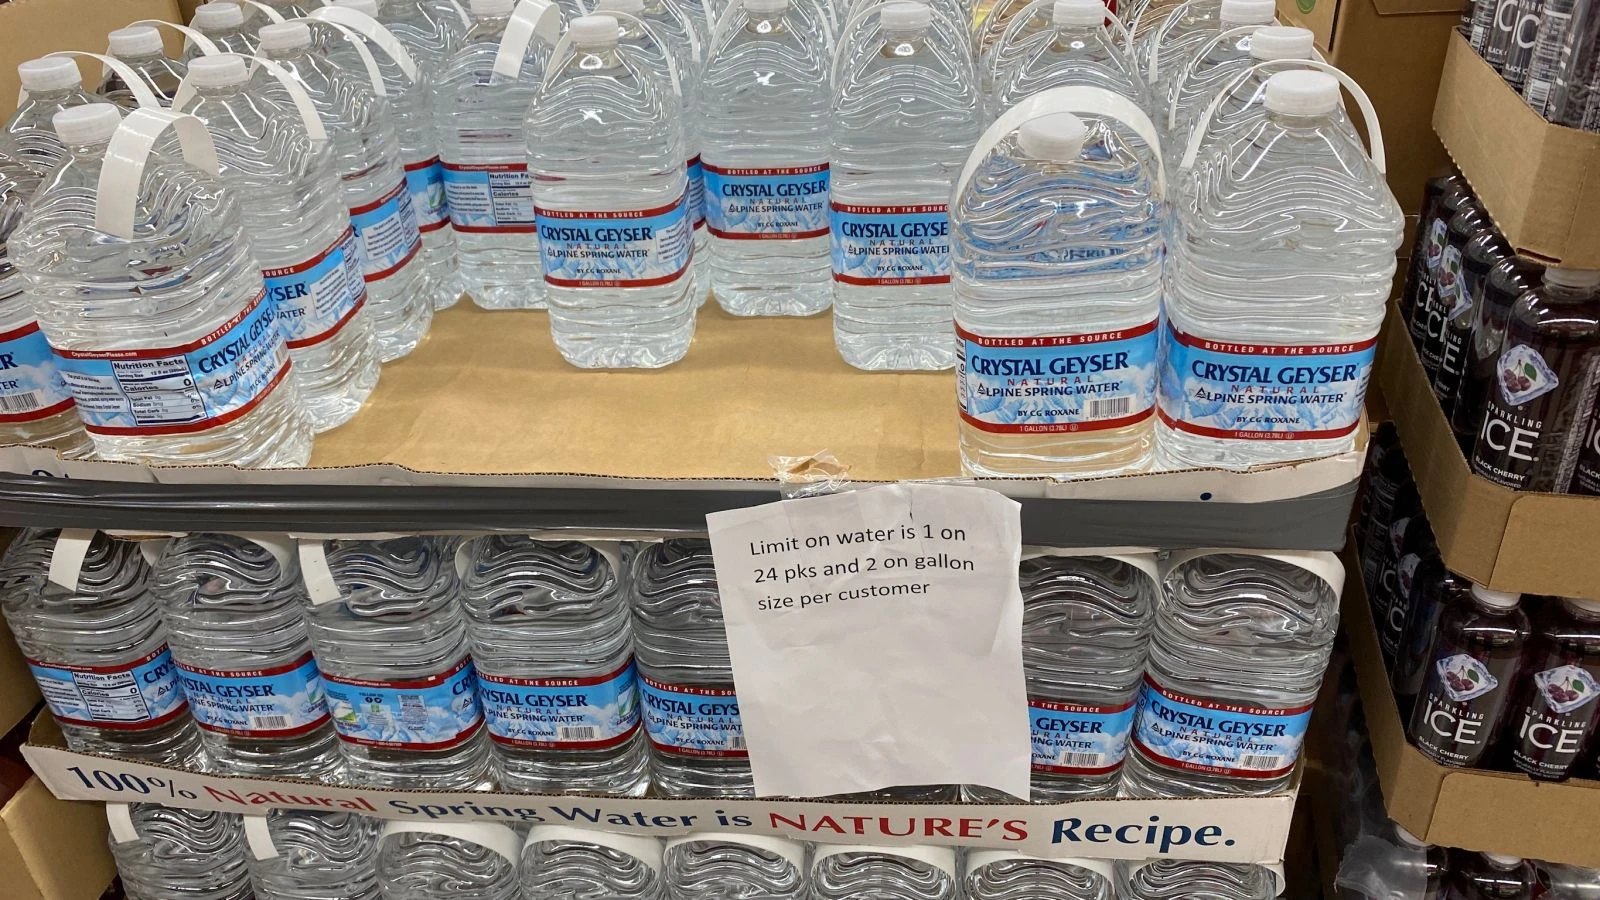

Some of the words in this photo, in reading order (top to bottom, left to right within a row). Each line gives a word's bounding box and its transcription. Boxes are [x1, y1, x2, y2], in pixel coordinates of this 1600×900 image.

[1512, 10, 1540, 48] IC
[794, 166, 821, 174] SOURCE
[722, 183, 774, 196] CRYSTAL
[776, 180, 828, 196] GEYSER
[542, 210, 574, 218] BOTTLED
[728, 204, 760, 212] ALPINE
[761, 204, 794, 212] SPRING
[795, 202, 823, 212] WATER
[541, 225, 594, 241] CRYSTAL
[594, 227, 652, 242] GEYSER
[842, 222, 898, 238] CRYSTAL
[900, 222, 948, 238] GEYSE
[548, 246, 578, 258] ALPINE
[580, 250, 614, 259] SPRING
[616, 250, 648, 258] WATER
[848, 244, 880, 256] ALPINE
[882, 246, 919, 256] SPRING
[269, 282, 308, 302] YSER
[978, 338, 1024, 346] BOTTLED
[1052, 336, 1072, 344] THE
[1080, 332, 1122, 343] SOURCE
[199, 335, 250, 374] CRYSTAL
[1205, 342, 1254, 353] BOTTLED
[1312, 344, 1354, 354] SOURCE
[113, 361, 154, 370] Nutrition
[157, 359, 184, 368] Facts
[971, 354, 1046, 376] CRYSTAL
[1049, 352, 1130, 374] GEYSER
[1192, 360, 1274, 383] CRYSTAL
[1277, 364, 1358, 384] GEYSER
[124, 384, 160, 392] Calories
[184, 378, 192, 386] 0
[213, 366, 246, 390] ALPINE
[1007, 374, 1094, 386] NATURAL
[977, 382, 1022, 397] ALPINE
[1024, 385, 1073, 397] SPRING
[1076, 382, 1120, 394] WATER
[1194, 386, 1245, 404] ALPINE
[1248, 394, 1298, 404] SPRING
[1300, 393, 1344, 404] WATER
[1230, 384, 1320, 394] NATURAL
[1044, 408, 1080, 416] ROXANE
[1236, 416, 1248, 424] BY
[1488, 400, 1542, 430] SPARKLING
[1481, 410, 1540, 461] ICE
[1476, 456, 1492, 472] BLACK
[1493, 467, 1526, 482] CHERRY
[750, 537, 800, 556] Limit
[806, 534, 831, 549] on
[836, 526, 896, 544] water
[900, 524, 916, 540] is
[922, 524, 934, 540] 1
[940, 528, 966, 542] on
[754, 567, 779, 584] 24
[784, 563, 818, 584] pks
[824, 558, 860, 577] and
[865, 558, 878, 572] 2
[884, 556, 908, 570] on
[914, 552, 975, 572] gallon
[757, 592, 794, 612] size
[800, 590, 832, 610] per
[838, 582, 931, 602] customer
[74, 672, 105, 681] Nutrition
[107, 672, 131, 680] Facts
[216, 684, 276, 698] GEYSER
[645, 678, 678, 692] BOTTLED
[206, 701, 239, 713] SPRING
[240, 703, 274, 712] WATER
[496, 704, 561, 714] NATURAL
[525, 694, 588, 708] GEYSER
[642, 688, 696, 715] CRYSTAL
[698, 704, 740, 716] GEYS
[1162, 690, 1202, 706] BOTTLED
[1250, 708, 1286, 716] SOURCE
[1429, 693, 1484, 720] SPARKLING
[510, 712, 548, 722] SPRING
[549, 714, 584, 723] WATER
[666, 713, 734, 724] NATURAL
[1151, 700, 1215, 731] CRYSTAL
[1218, 720, 1287, 737] GEYSER
[1424, 700, 1482, 744] ICE
[1526, 706, 1587, 728] SPARKLING
[680, 722, 718, 731] SPRING
[1036, 717, 1103, 734] GEYSER
[1520, 714, 1584, 753] ICE
[1151, 722, 1190, 742] ALPINE
[1193, 735, 1234, 749] SPRING
[1236, 740, 1274, 751] WATER
[1180, 726, 1252, 742] NATURAL
[1056, 740, 1092, 748] WATER
[1419, 736, 1438, 752] BLACK
[1440, 748, 1470, 760] CHERRY
[1205, 754, 1236, 763] ROXANE
[1514, 750, 1538, 765] BLACK
[1539, 762, 1568, 770] CHERRY
[67, 766, 198, 800] 100%
[204, 784, 380, 812] Natural
[389, 799, 546, 822] Spring
[548, 806, 698, 828] Water
[718, 810, 753, 828] is
[768, 812, 1029, 842] NATURE'S
[1051, 814, 1236, 853] Recipe.
